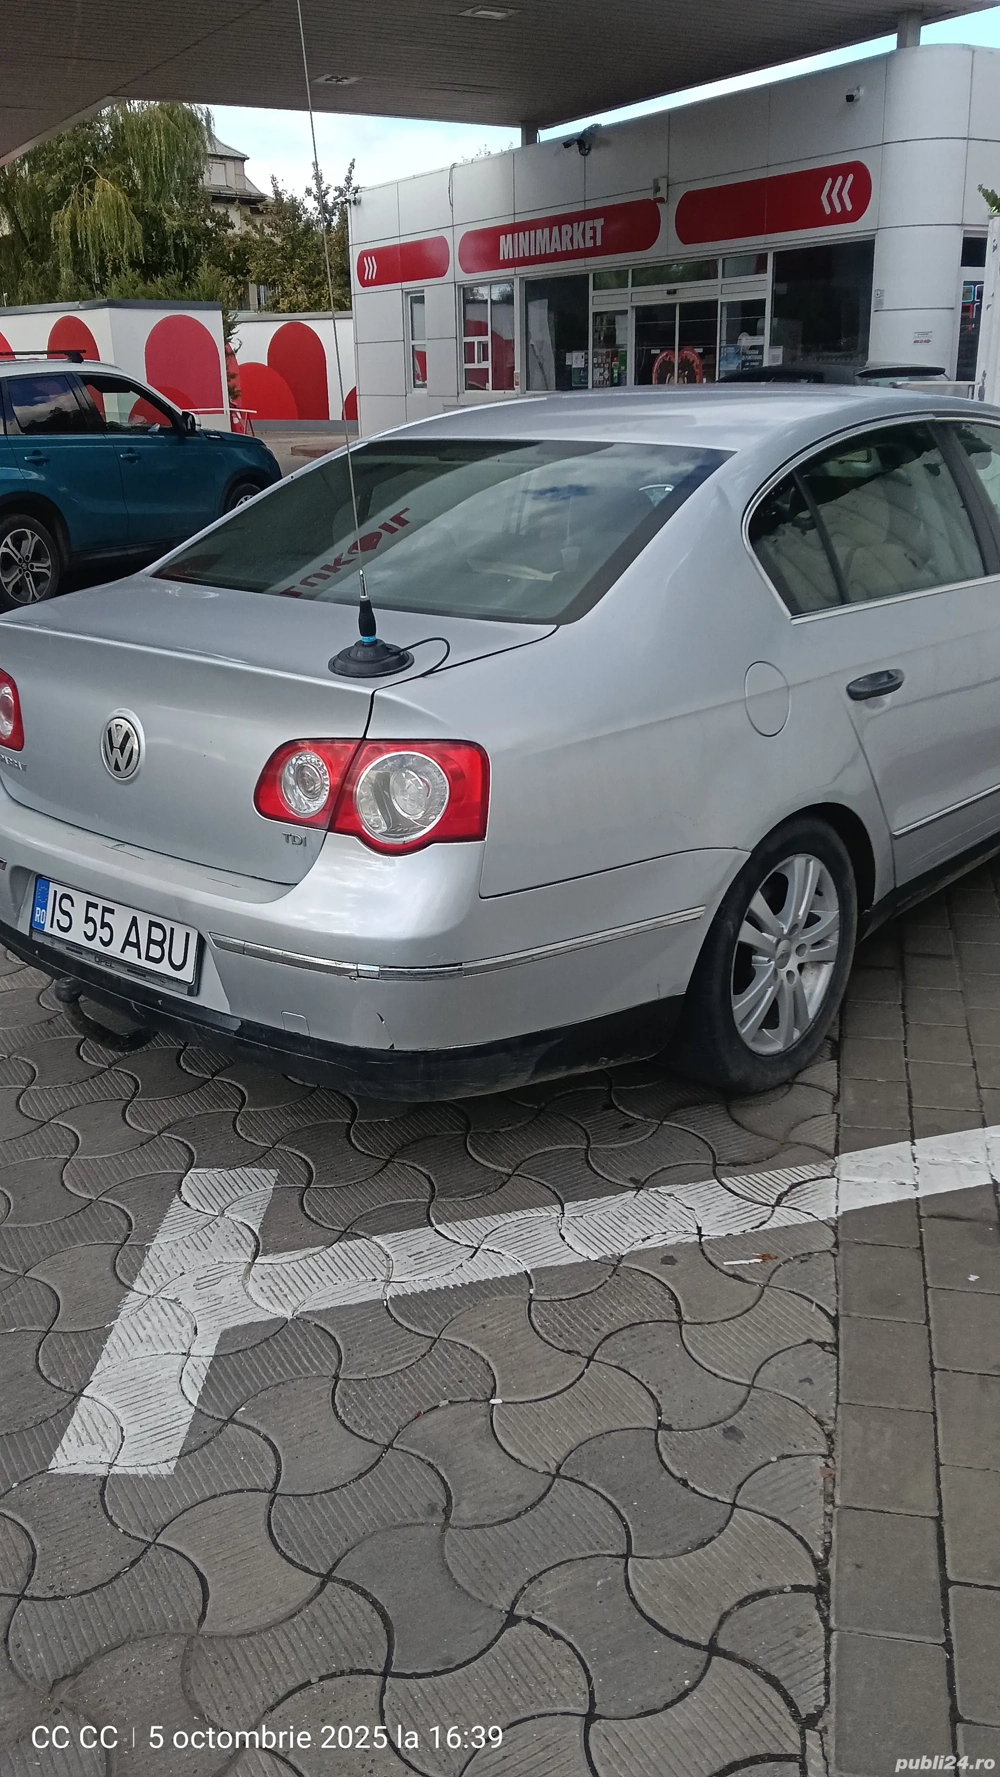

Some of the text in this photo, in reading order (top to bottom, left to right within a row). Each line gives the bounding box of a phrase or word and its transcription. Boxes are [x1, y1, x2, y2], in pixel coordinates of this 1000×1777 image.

[499, 218, 604, 260] MINIMARKET
[282, 831, 307, 847] TDI
[34, 907, 46, 924] RO
[50, 889, 190, 971] IS 55 ABU
